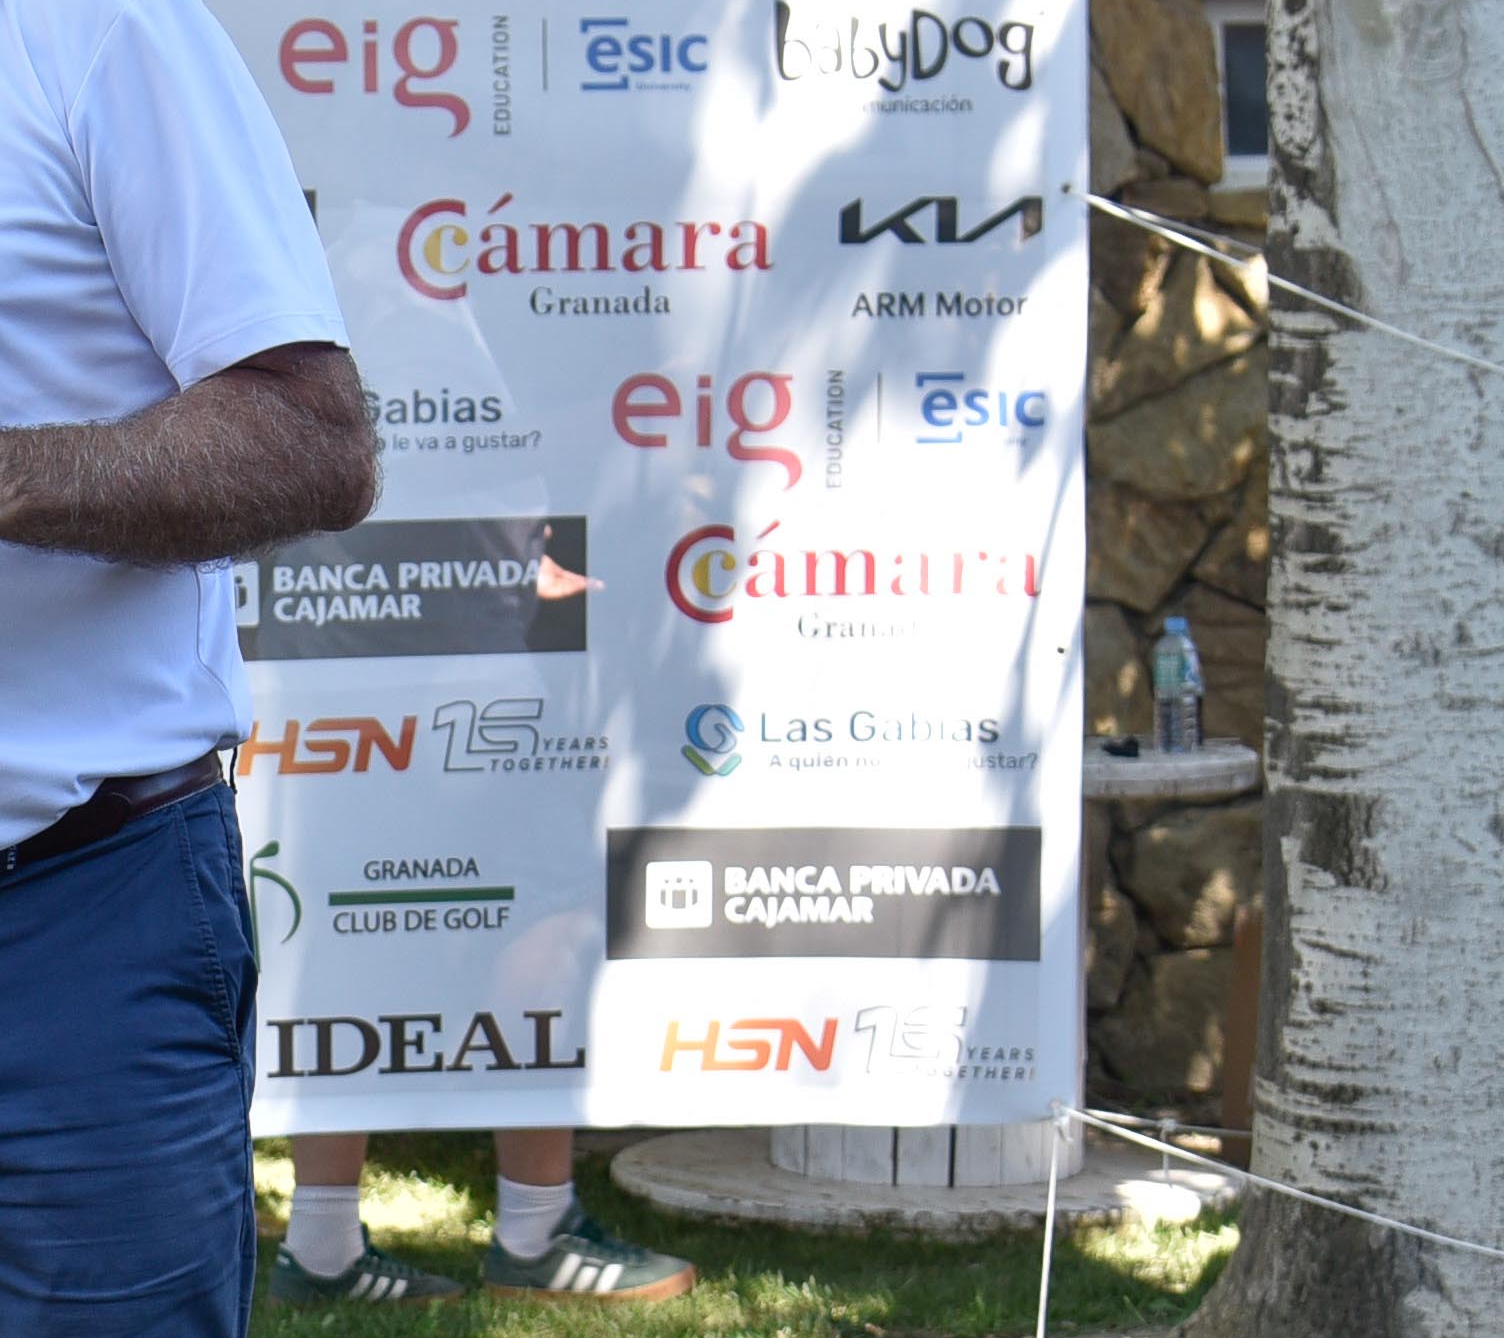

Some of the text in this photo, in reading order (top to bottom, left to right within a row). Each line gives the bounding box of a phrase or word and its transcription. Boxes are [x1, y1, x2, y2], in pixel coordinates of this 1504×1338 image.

[279, 15, 471, 139] eig
[493, 13, 511, 137] EDUCATION
[396, 192, 776, 302] Cámara
[528, 285, 672, 318] Granada
[851, 290, 1028, 319] ARM Motor
[392, 430, 543, 454] le va a gustar?
[610, 371, 803, 491] eig
[825, 369, 844, 489] EDUCATION
[271, 559, 542, 594] BANCA PRIVADA
[663, 520, 1042, 625] Cámara
[272, 592, 422, 623] CAJAMAR
[236, 697, 544, 776] HSN 15
[543, 735, 610, 753] YEARS
[759, 712, 834, 743] Las
[489, 755, 611, 774] TOGETHER!
[362, 858, 481, 883] GRANADA
[723, 864, 1002, 898] BANCA PRIVADA
[332, 905, 512, 935] CLUB DE GOLF
[724, 895, 874, 927] CAJAMAR
[266, 1008, 587, 1080] IDEAL
[658, 1017, 839, 1073] HSN
[966, 1046, 1036, 1062] YEARS
